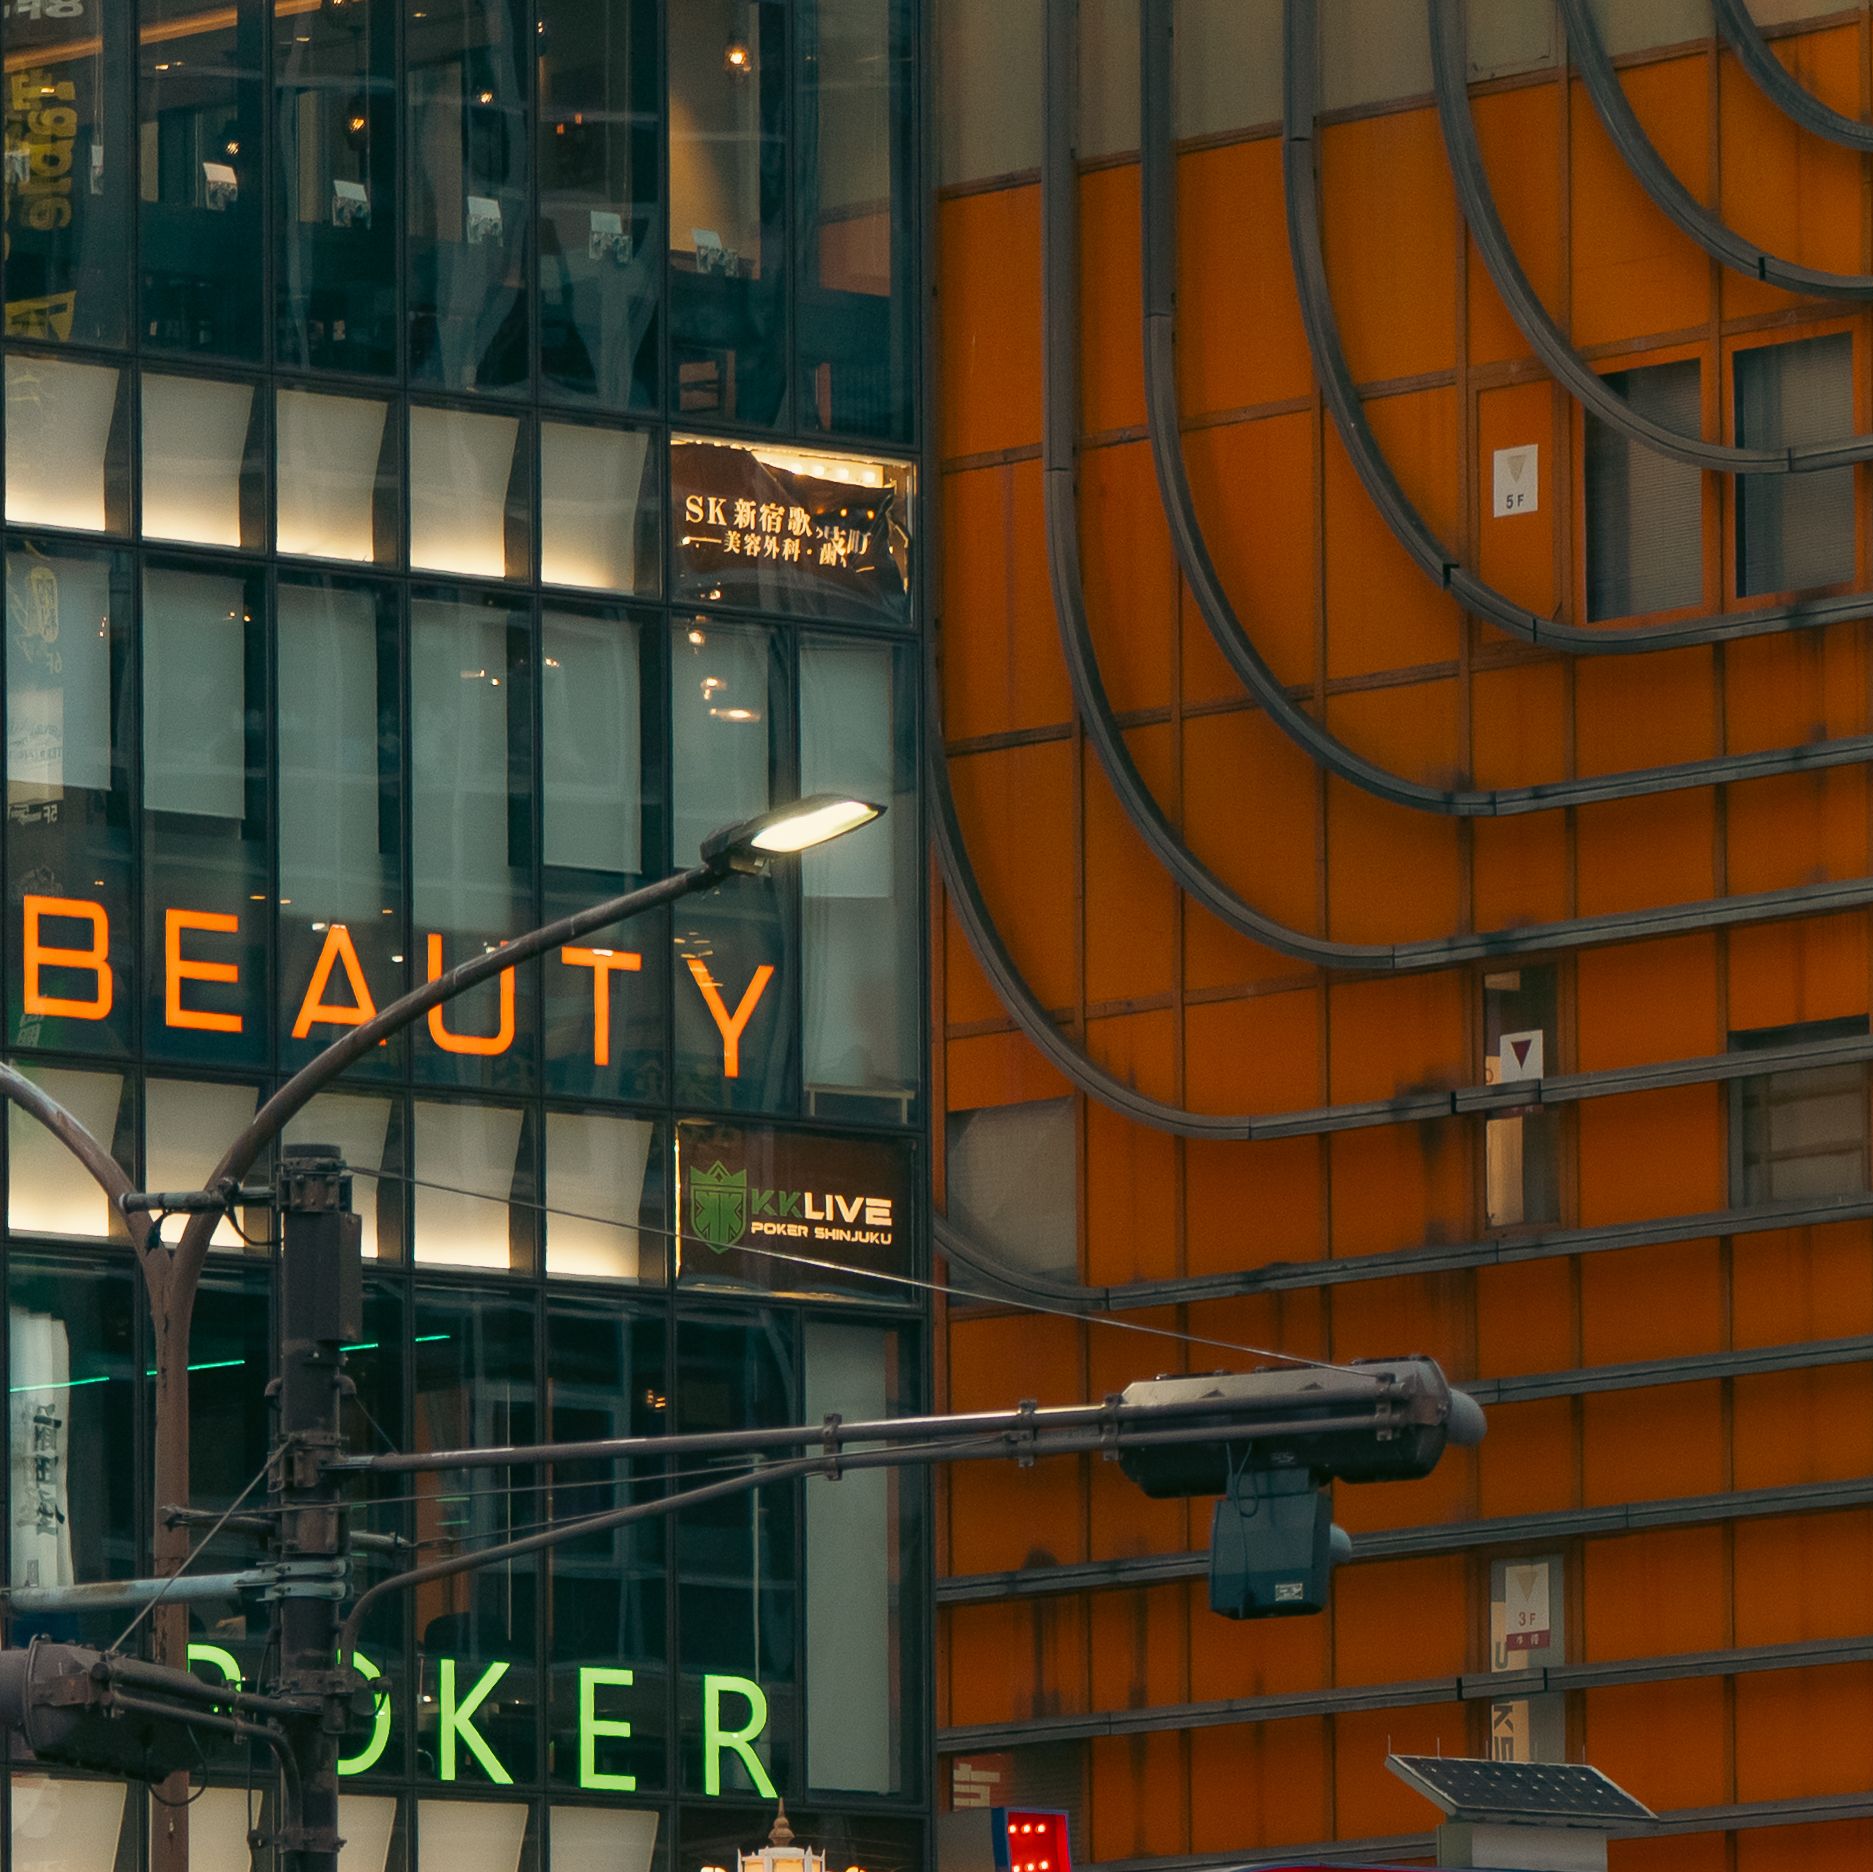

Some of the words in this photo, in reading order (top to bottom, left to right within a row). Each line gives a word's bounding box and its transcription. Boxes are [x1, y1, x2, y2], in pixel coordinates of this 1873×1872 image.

[684, 496, 727, 526] SK
[22, 894, 776, 1079] BEAUTY
[751, 1221, 809, 1238] POKER
[814, 1226, 893, 1246] SHINJUKU
